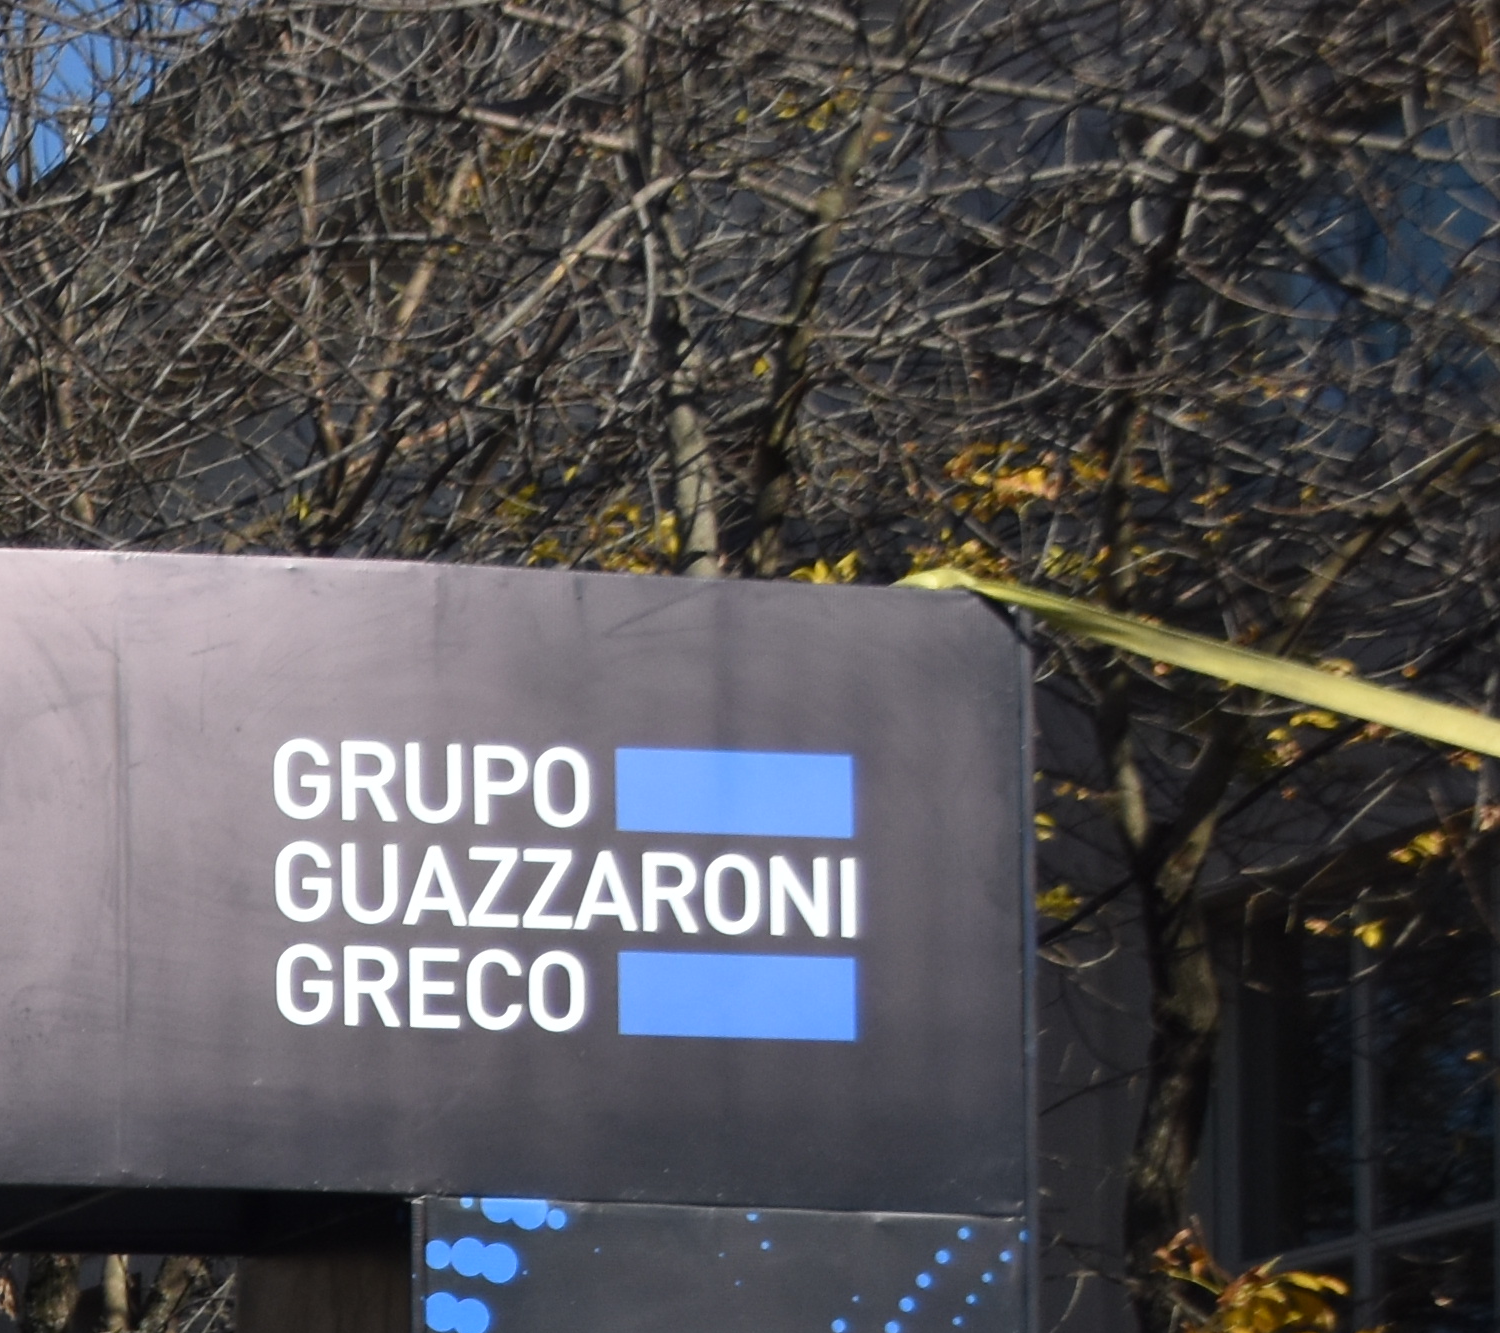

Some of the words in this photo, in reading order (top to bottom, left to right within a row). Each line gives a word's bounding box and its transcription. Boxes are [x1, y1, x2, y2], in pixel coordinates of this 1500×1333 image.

[273, 739, 592, 828] GRUPO
[274, 841, 860, 938] GUAZZARONI
[275, 945, 588, 1033] GRECO
